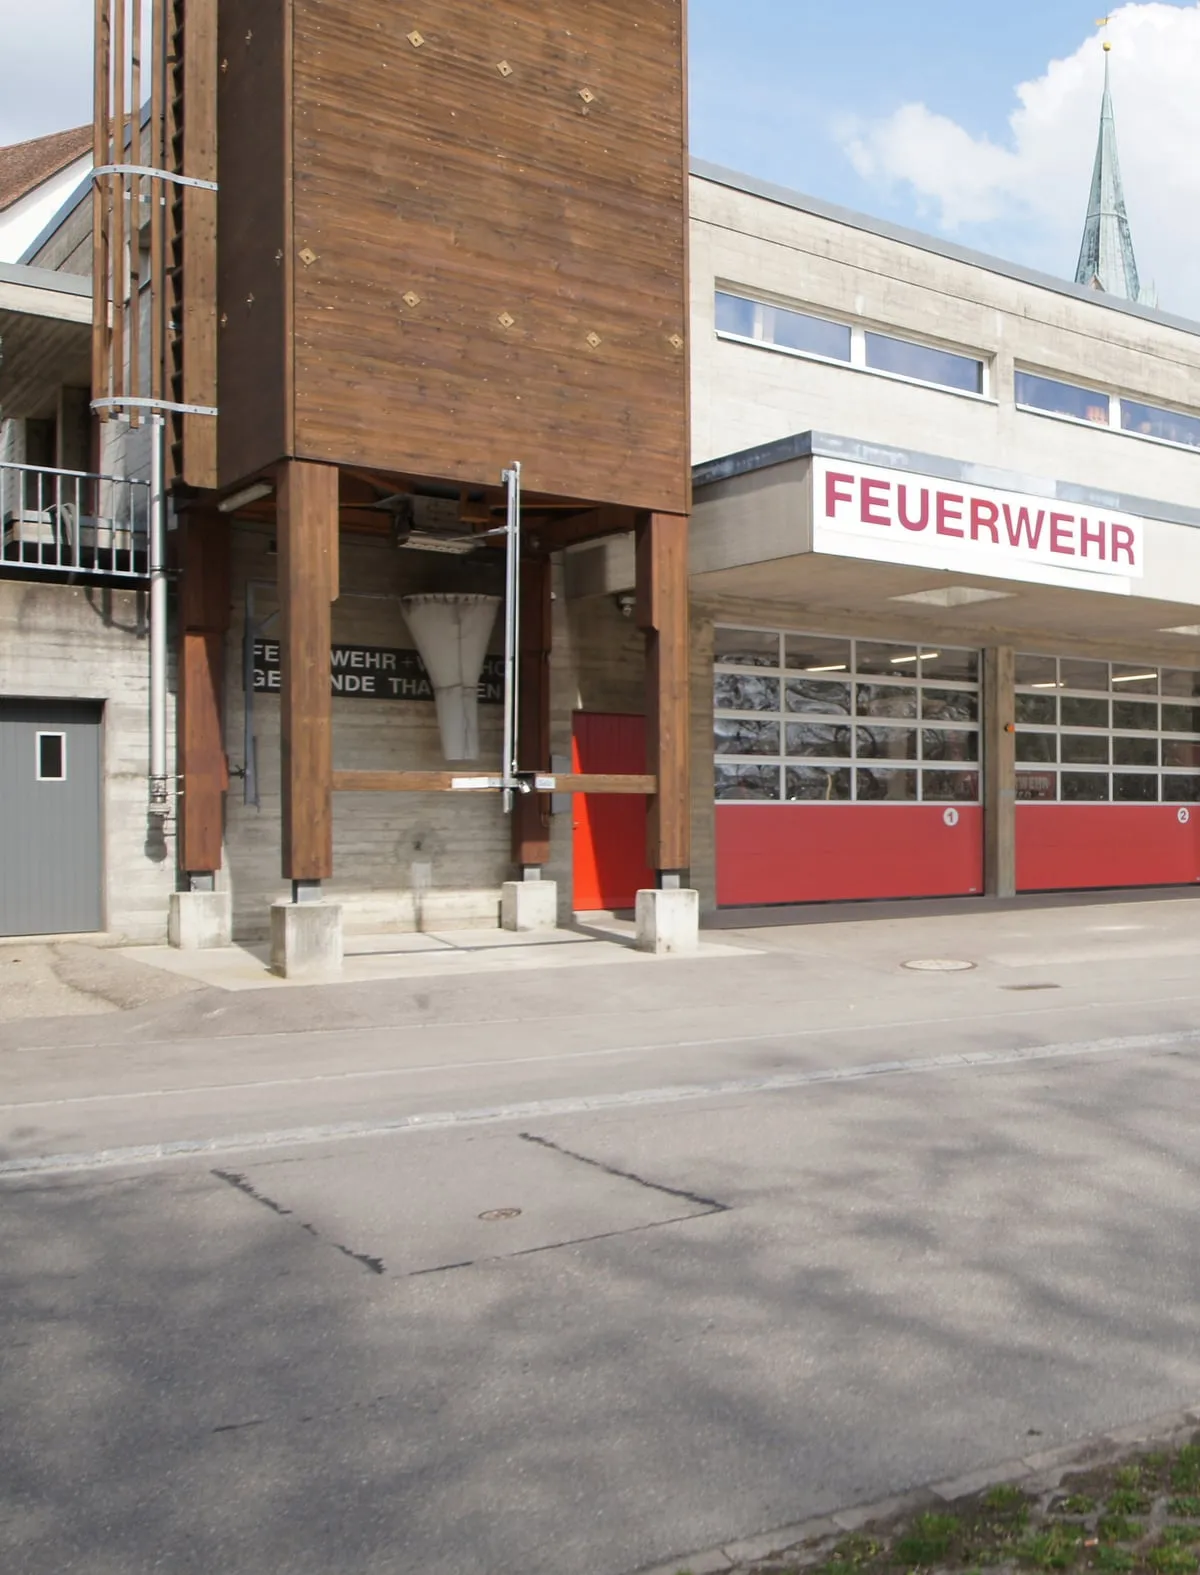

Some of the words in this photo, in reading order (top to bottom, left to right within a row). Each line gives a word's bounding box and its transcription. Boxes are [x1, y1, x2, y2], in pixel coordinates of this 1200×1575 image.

[825, 470, 1136, 566] FEUERWEHR
[252, 643, 397, 671] FEWEHR
[252, 668, 377, 693] GENDE
[388, 676, 501, 699] THAEN
